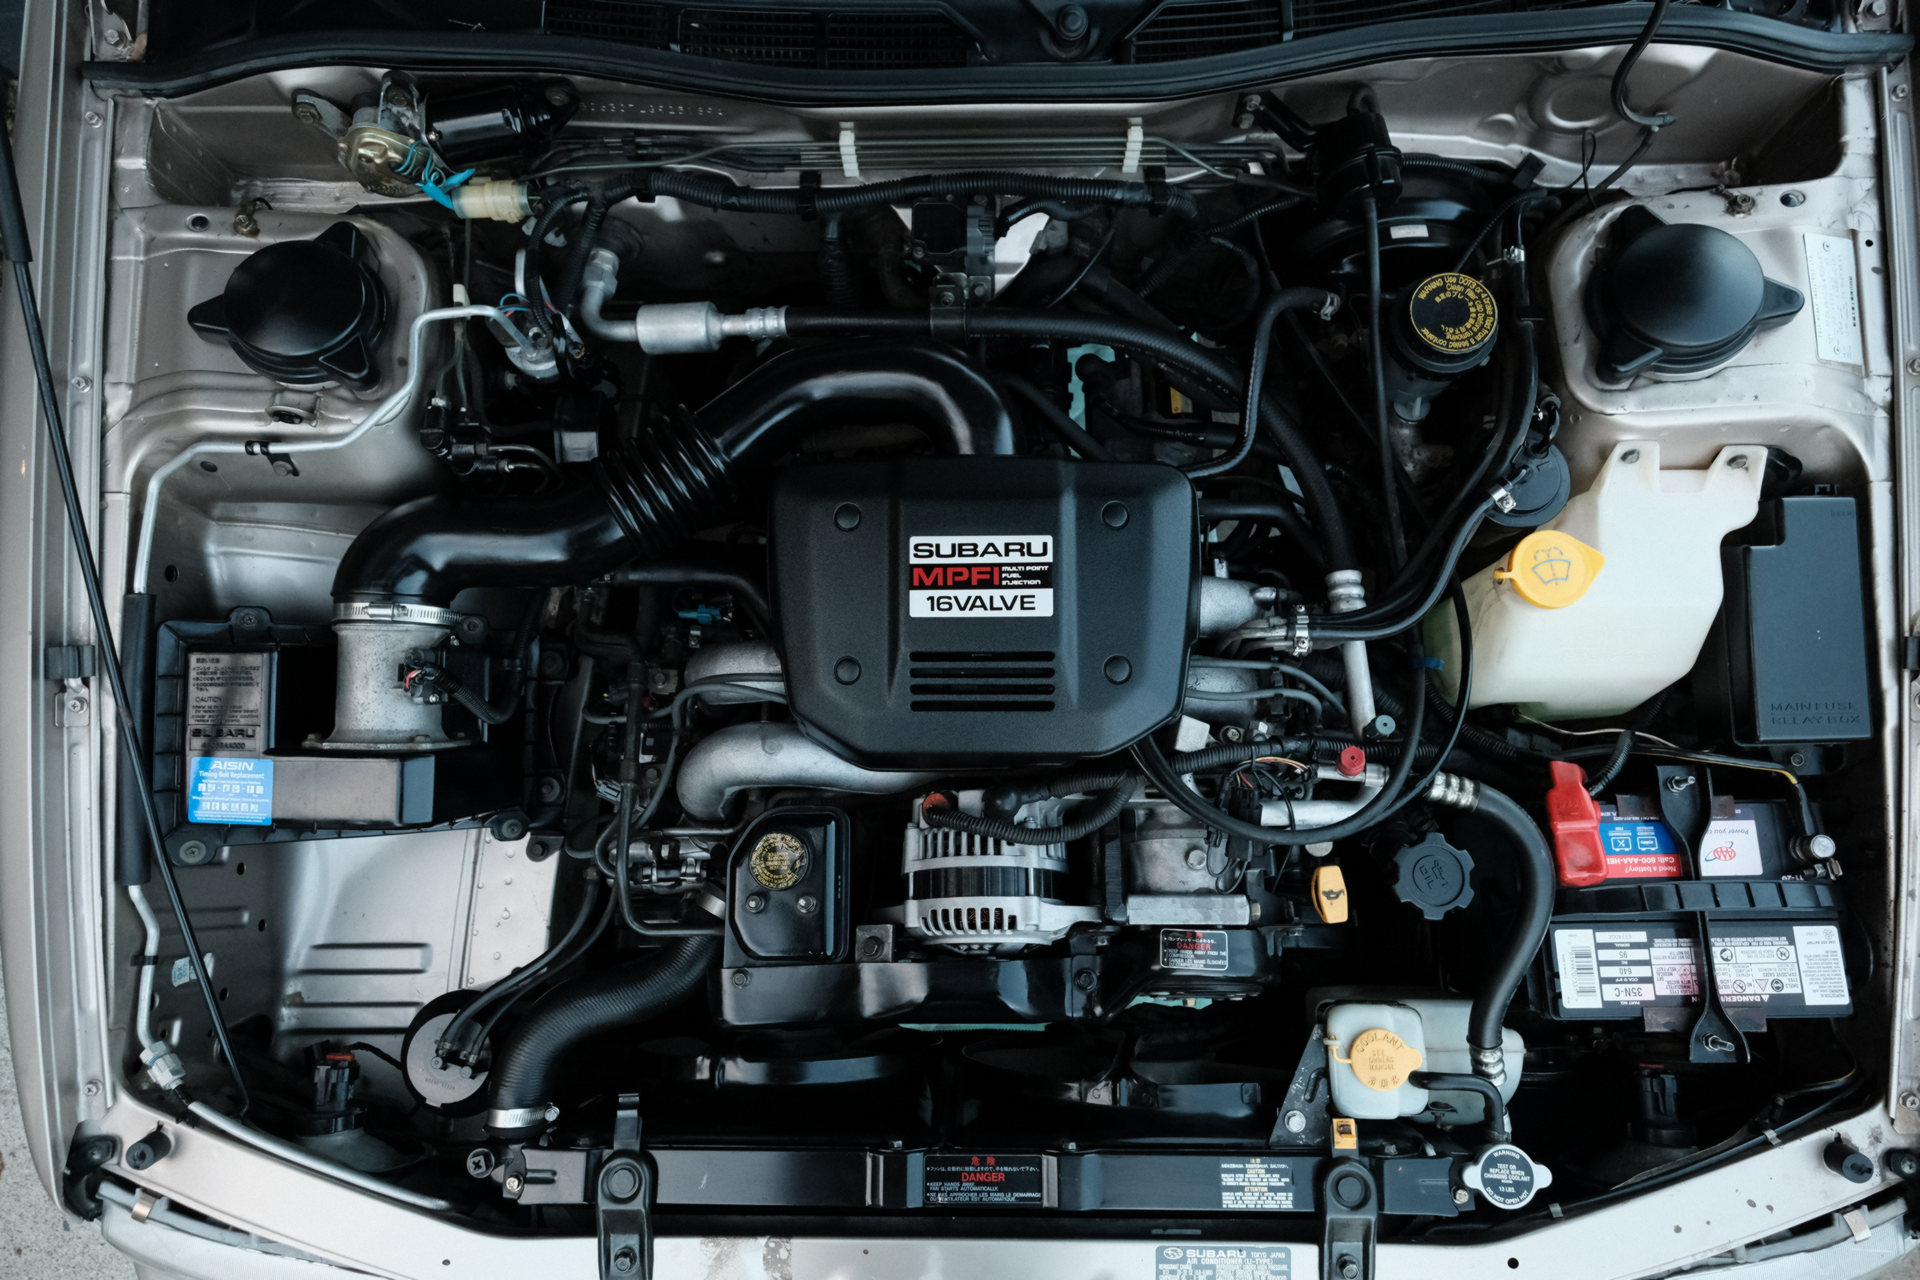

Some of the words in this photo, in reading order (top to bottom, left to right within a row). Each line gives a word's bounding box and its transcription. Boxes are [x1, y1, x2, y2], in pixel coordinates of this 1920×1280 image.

[1418, 278, 1443, 299] WARNING
[1446, 284, 1464, 292] Clean
[1459, 277, 1476, 289] DOT3
[1475, 300, 1484, 312] cap
[1483, 298, 1493, 315] brake
[1472, 313, 1485, 332] before
[1448, 340, 1470, 348] sealed
[913, 542, 1048, 558] SUBARU
[912, 566, 1000, 586] MPFI
[926, 595, 1036, 612] 16VALVE
[1771, 703, 1811, 712] MAIN
[1816, 702, 1858, 711] FUSE
[1771, 716, 1823, 724] RELAY
[1828, 715, 1861, 724] BOX
[192, 728, 256, 738] SUBARU
[210, 760, 254, 771] AISIN
[200, 770, 218, 778] Timing
[1713, 847, 1736, 861] AAA
[1418, 865, 1434, 890] OIL
[1176, 942, 1211, 950] DANGER
[1614, 987, 1642, 997] 35N-C
[1355, 1032, 1404, 1053] COOLANT
[1493, 1150, 1520, 1160] WARNING
[961, 1172, 1005, 1182] DANGER
[1486, 1186, 1494, 1196] DO
[1494, 1194, 1504, 1202] NOT
[1520, 1190, 1528, 1200] HOT
[1186, 1249, 1246, 1258] SUBARU
